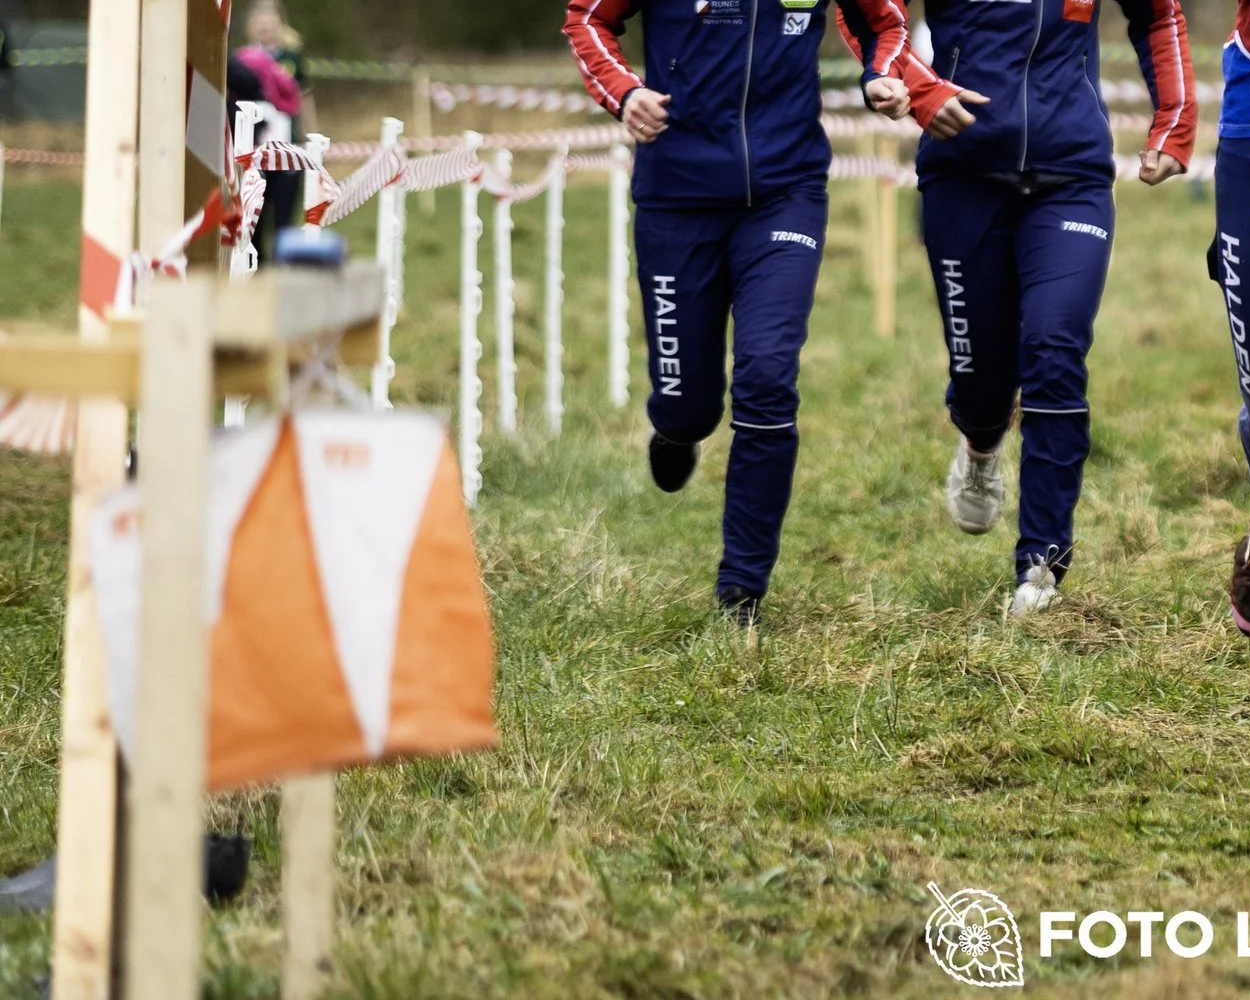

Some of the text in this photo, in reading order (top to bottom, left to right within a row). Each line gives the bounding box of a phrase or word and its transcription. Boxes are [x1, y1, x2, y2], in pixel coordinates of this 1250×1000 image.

[711, 0, 741, 8] RUNES
[770, 230, 817, 250] TRIMTEX
[1061, 220, 1108, 240] TRIMTEX
[942, 258, 975, 373] HALDEN
[652, 275, 683, 396] HALDEN
